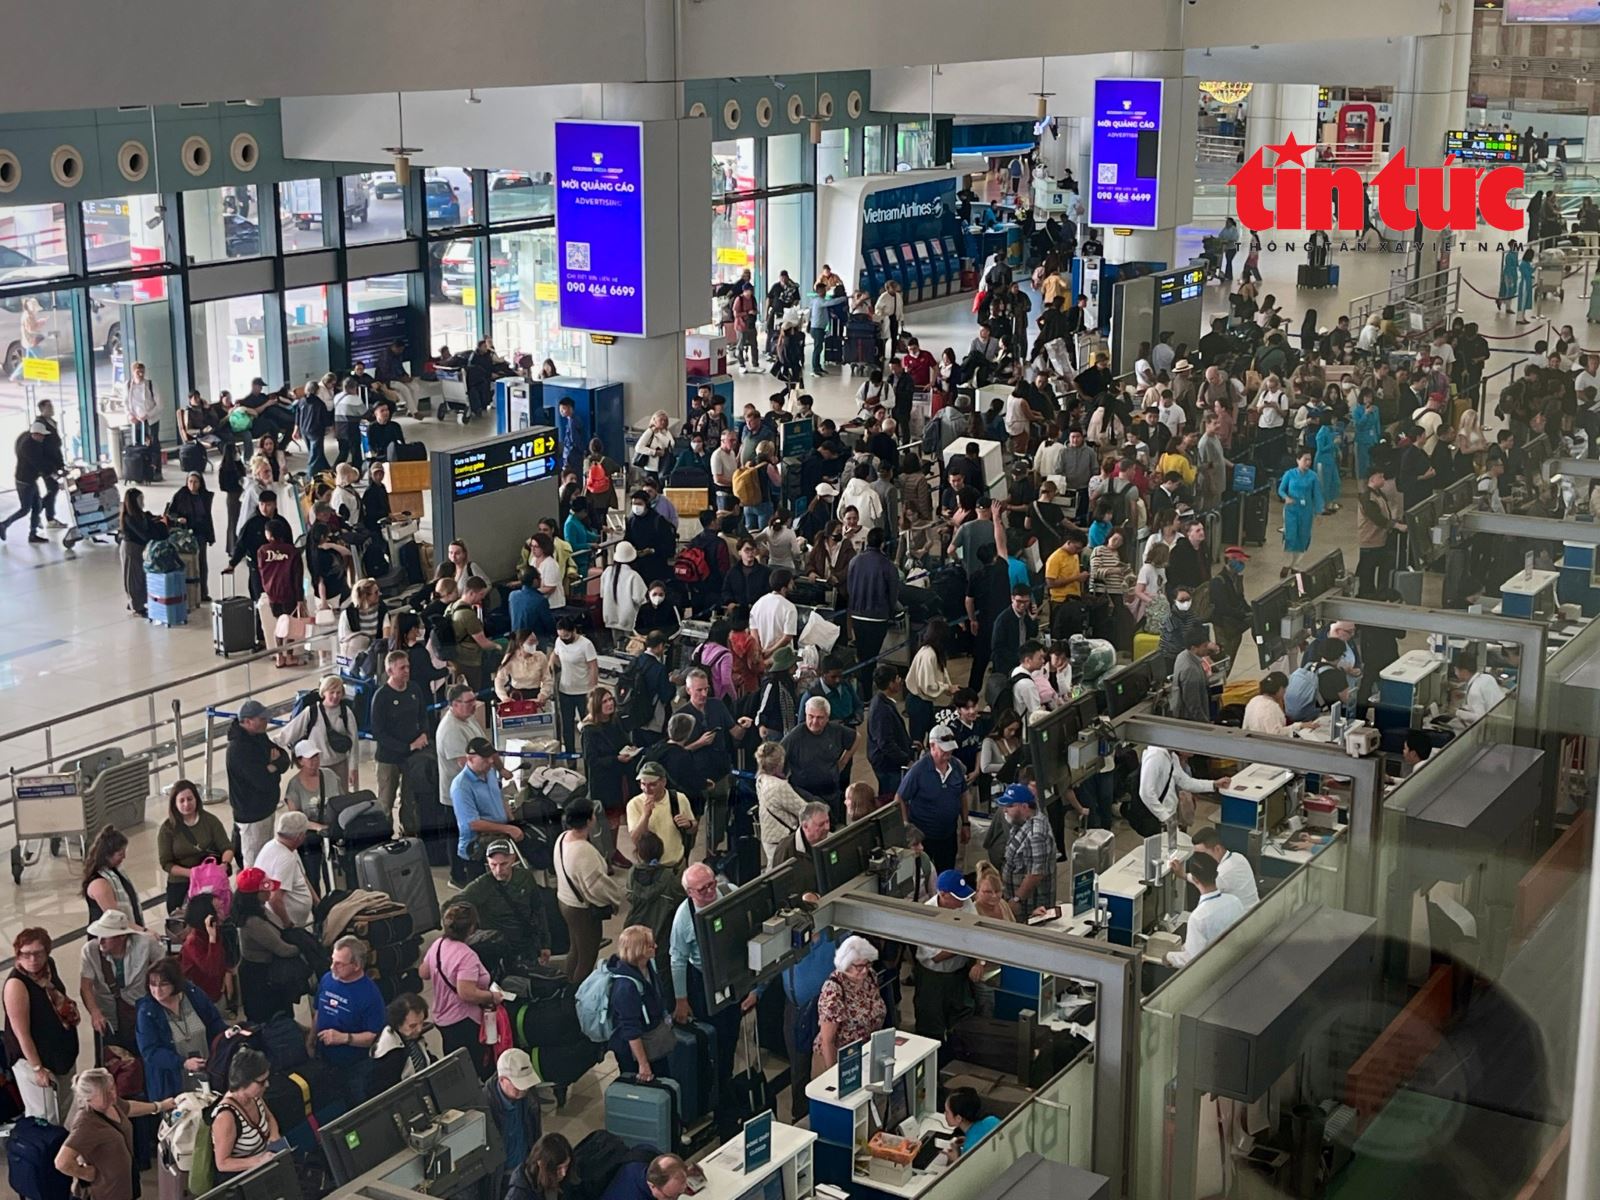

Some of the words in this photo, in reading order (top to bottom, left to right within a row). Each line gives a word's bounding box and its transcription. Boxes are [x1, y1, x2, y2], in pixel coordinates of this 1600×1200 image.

[561, 179, 580, 189] MỜI
[581, 179, 613, 191] QUẢNG
[615, 182, 635, 192] CÁO
[1097, 192, 1112, 200] 090
[1131, 193, 1151, 202] 6699
[863, 208, 900, 224] Vietnam
[900, 202, 932, 219] Airlines
[566, 281, 585, 293] 090
[588, 283, 607, 295] 464
[610, 285, 635, 297] 6699
[510, 441, 533, 461] 1-17
